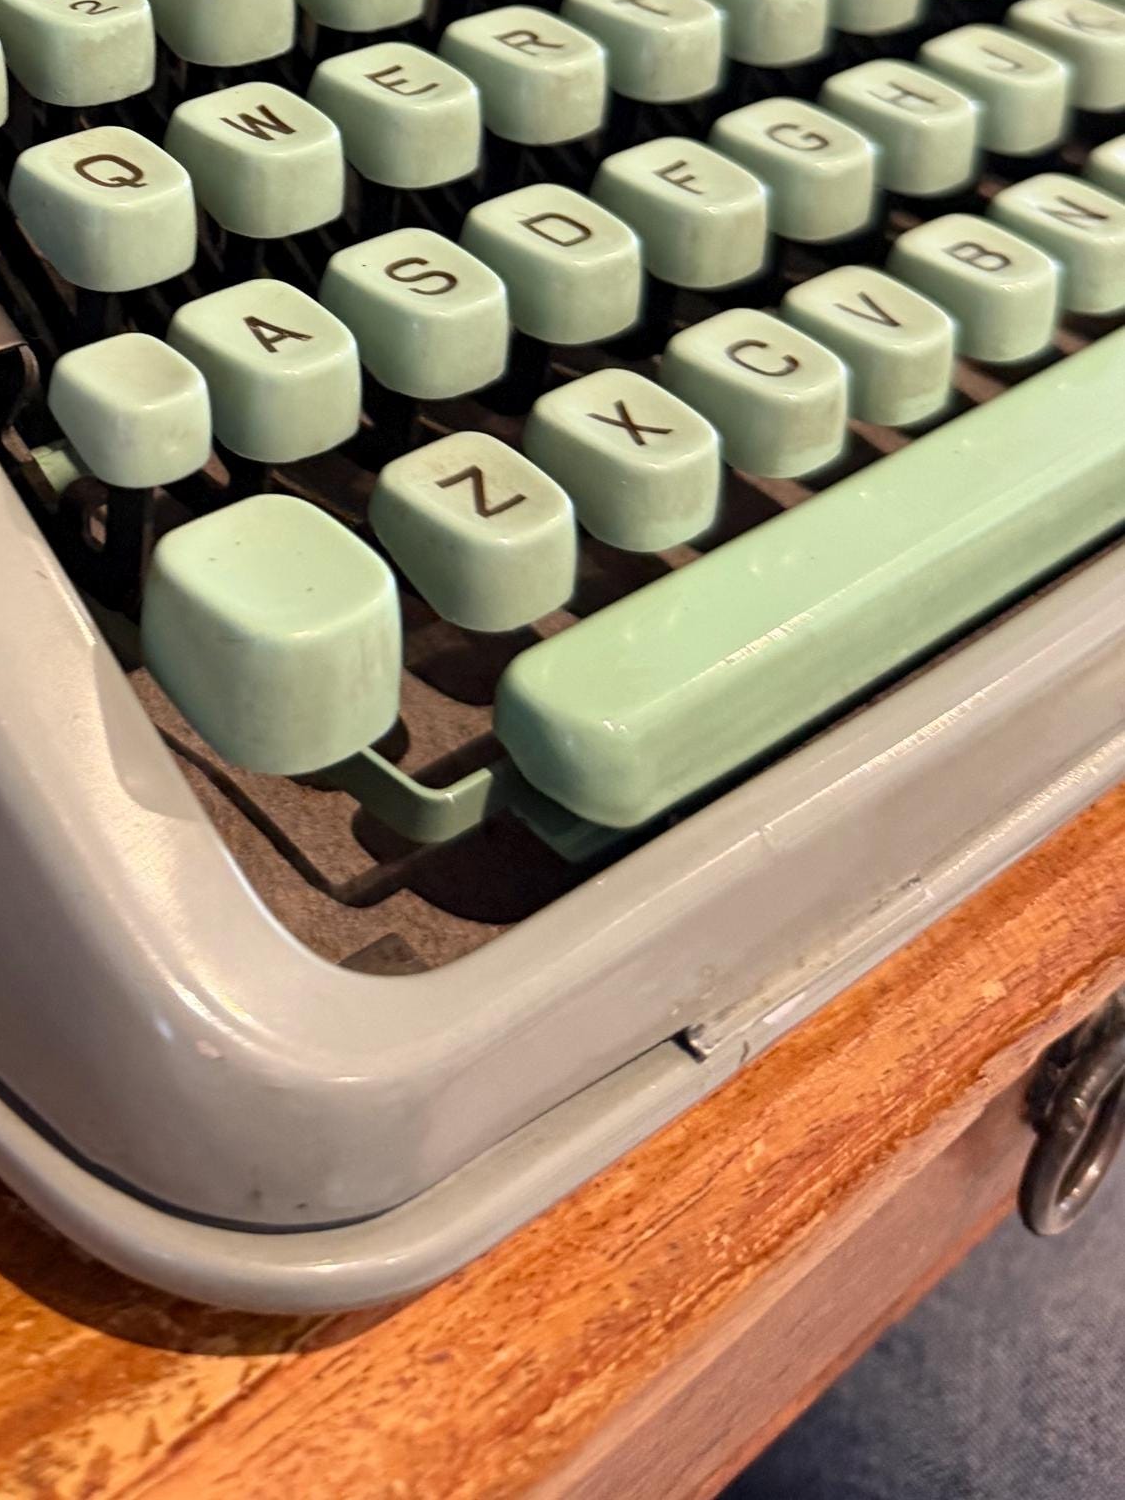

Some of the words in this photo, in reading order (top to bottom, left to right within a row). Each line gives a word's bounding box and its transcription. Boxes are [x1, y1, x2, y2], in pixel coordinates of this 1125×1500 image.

[68, 0, 120, 16] 2
[493, 29, 565, 57] R
[364, 64, 440, 97] E
[870, 80, 940, 112] H
[219, 104, 298, 142] W
[765, 121, 830, 152] G
[75, 154, 148, 189] Q
[653, 159, 705, 196] F
[520, 212, 593, 248] D
[1037, 195, 1109, 230] N
[942, 240, 1012, 273] B
[384, 256, 458, 296] S
[833, 291, 902, 331] V
[243, 314, 314, 354] A
[724, 338, 800, 378] C
[587, 399, 674, 447] X
[435, 465, 528, 519] Z
